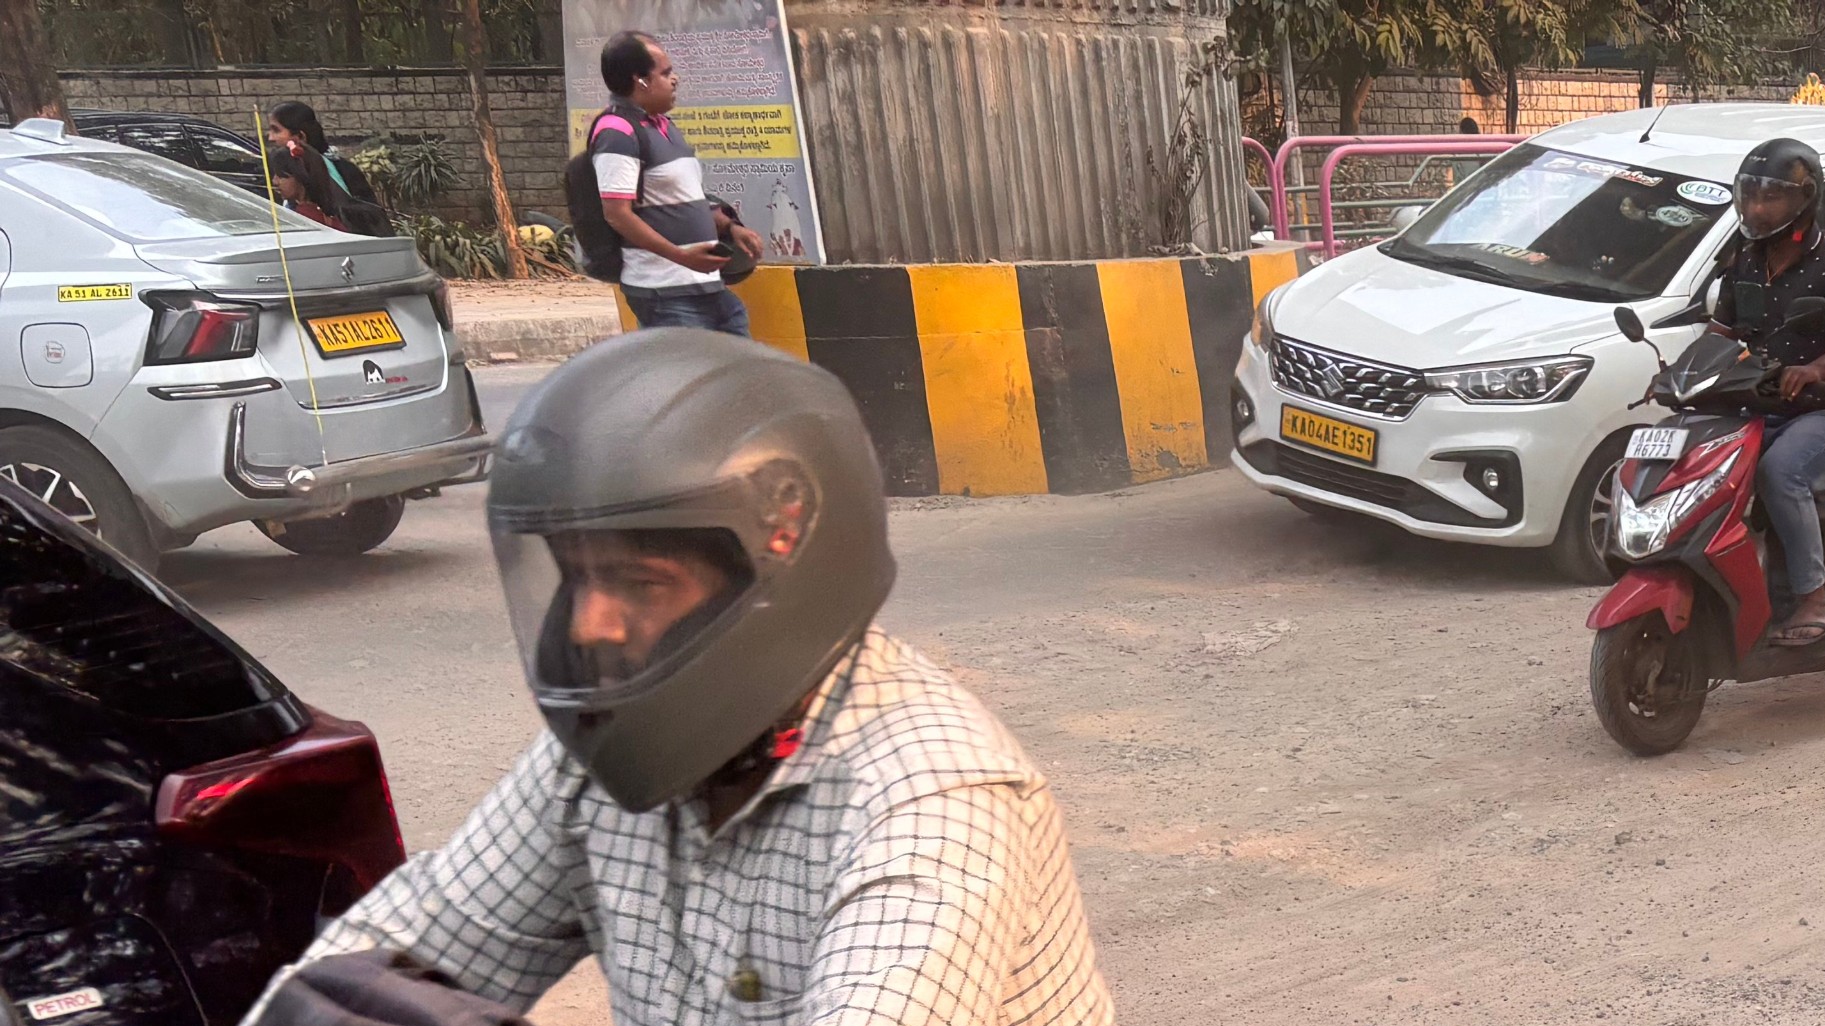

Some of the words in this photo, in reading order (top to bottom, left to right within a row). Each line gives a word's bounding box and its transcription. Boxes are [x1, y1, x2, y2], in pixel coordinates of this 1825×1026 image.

[60, 288, 73, 299] KA
[91, 286, 103, 298] AL
[317, 317, 398, 346] KA51AL2611
[1291, 415, 1372, 455] KA04AE1351
[34, 993, 97, 1016] PETROL
